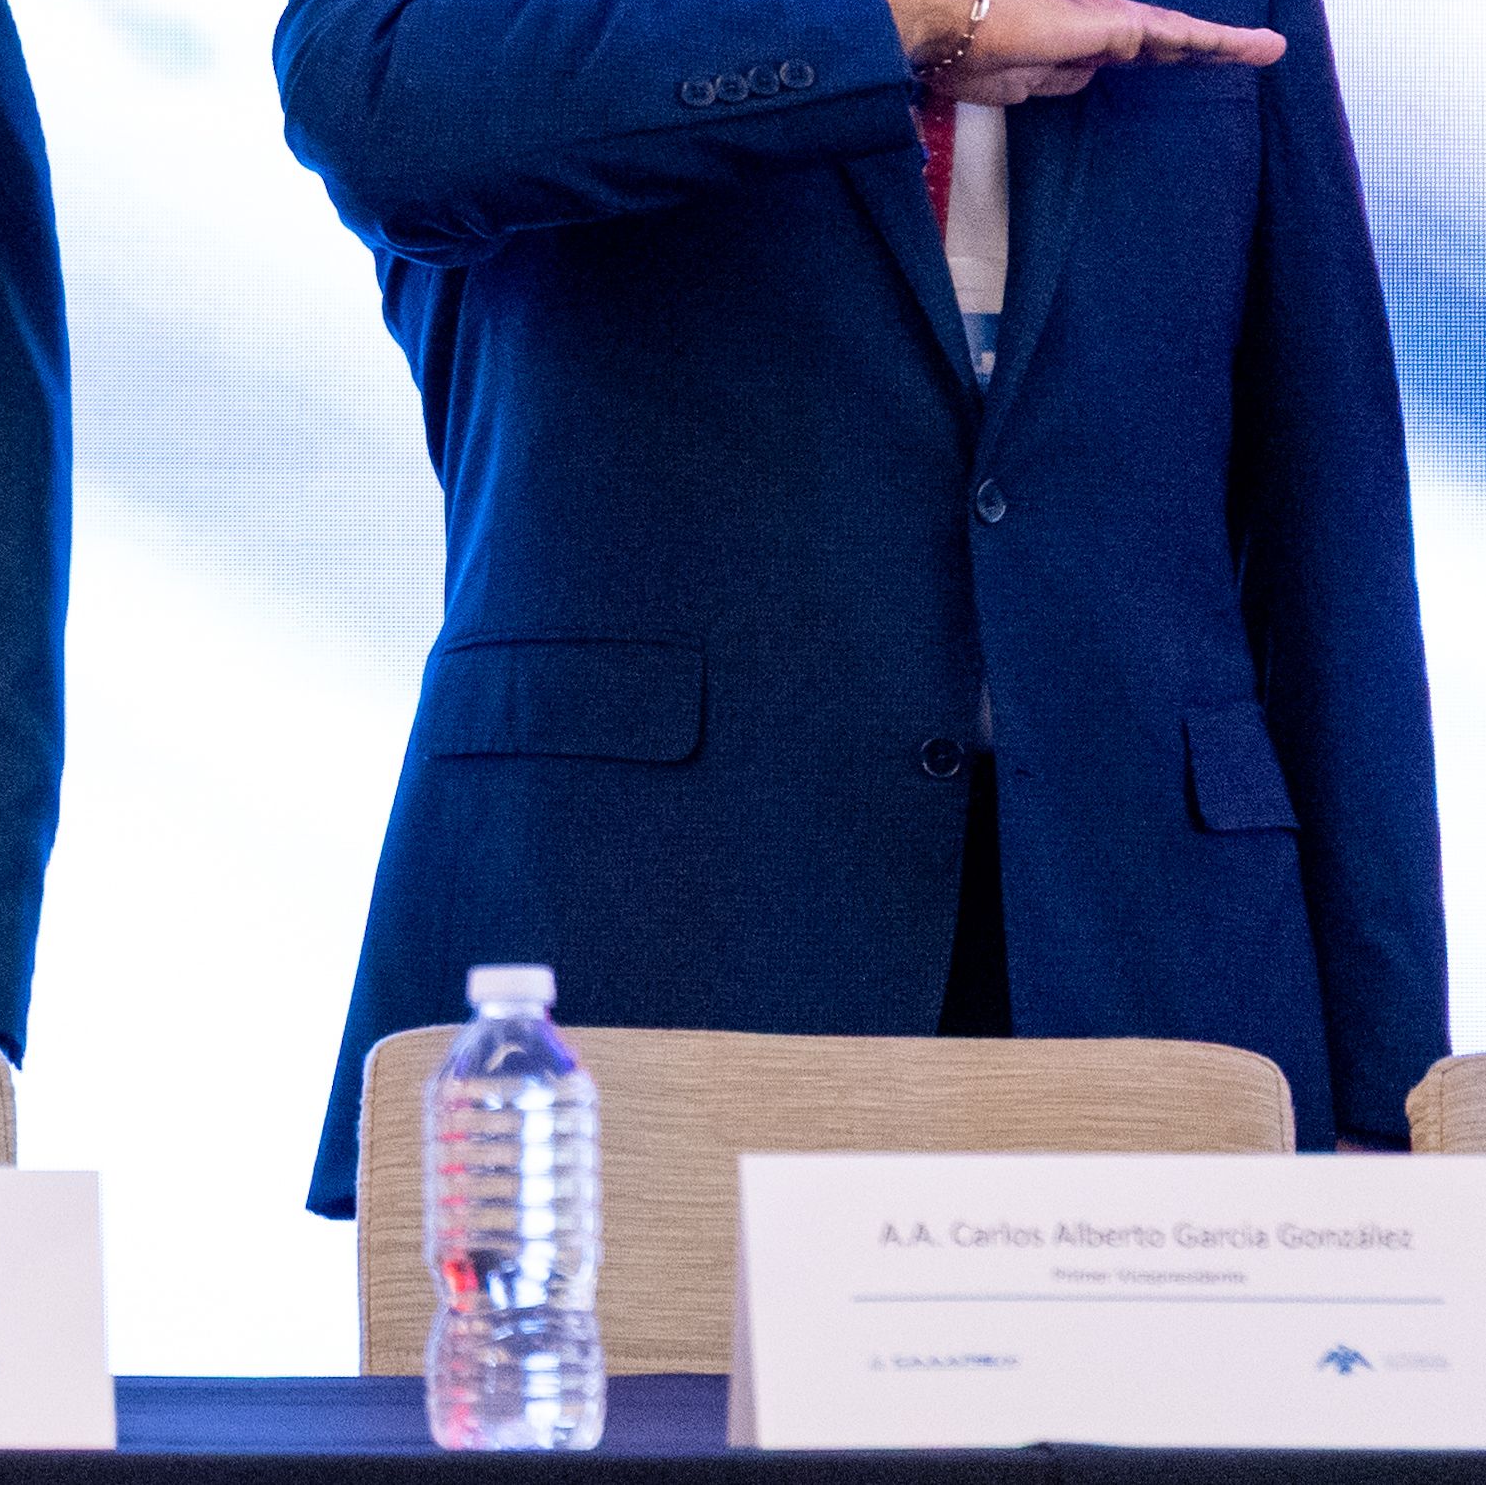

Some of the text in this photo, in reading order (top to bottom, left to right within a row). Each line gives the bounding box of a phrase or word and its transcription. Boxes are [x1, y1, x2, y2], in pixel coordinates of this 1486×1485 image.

[877, 1220, 940, 1248] A.A.
[948, 1220, 1045, 1249] Carlos
[1051, 1220, 1166, 1249] Alberto
[1276, 1220, 1415, 1251] González
